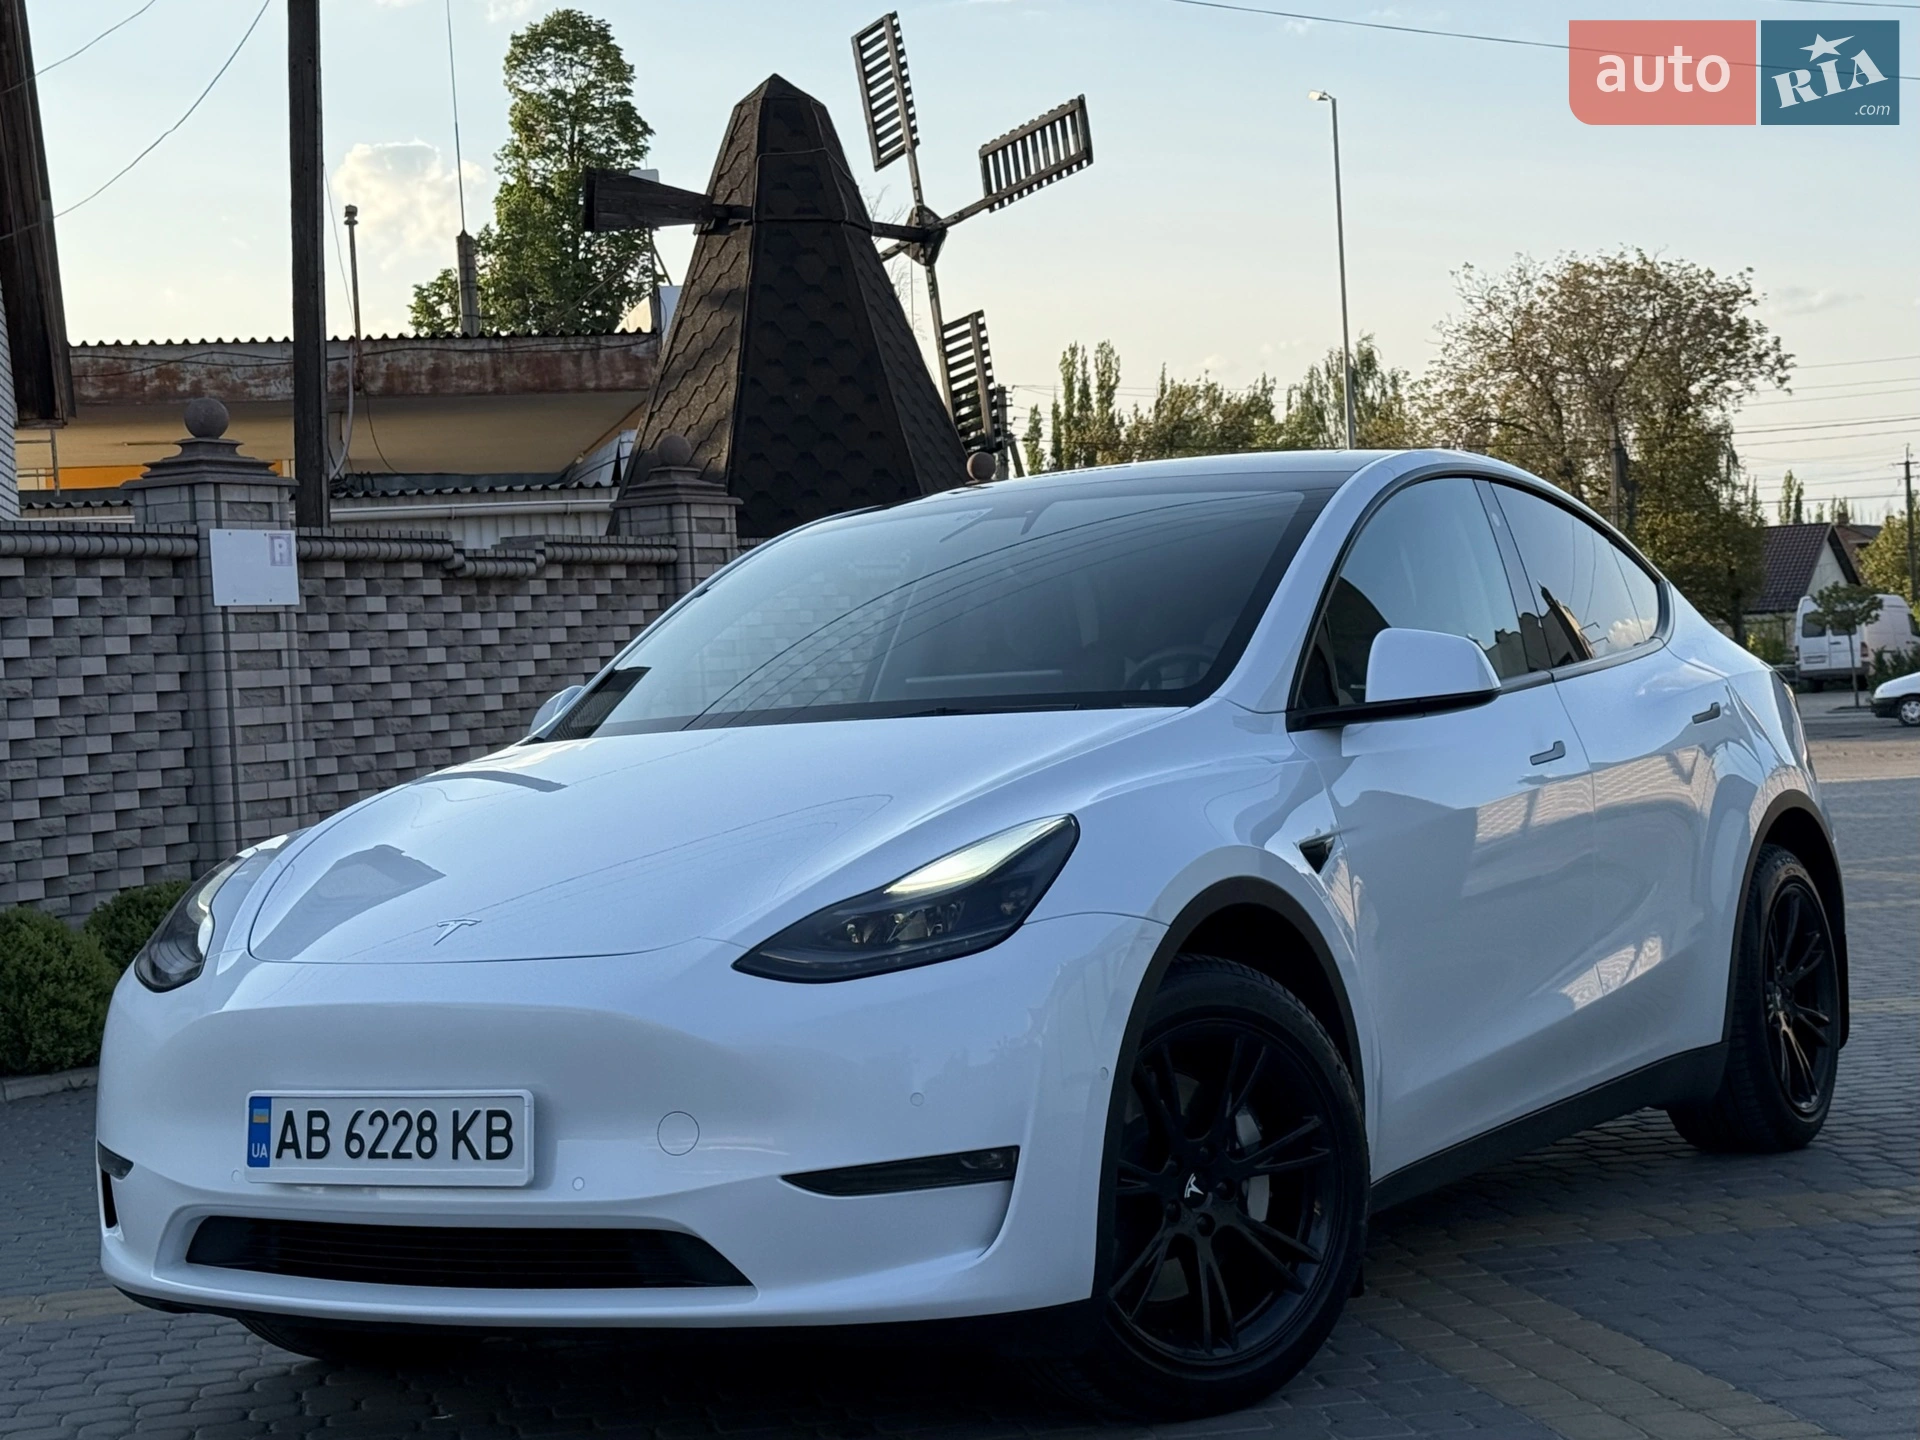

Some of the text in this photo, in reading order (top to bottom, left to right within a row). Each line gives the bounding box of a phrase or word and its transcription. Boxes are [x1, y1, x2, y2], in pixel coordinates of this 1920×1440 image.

[251, 1143, 268, 1158] UA
[275, 1109, 514, 1160] AB 6228 KB
